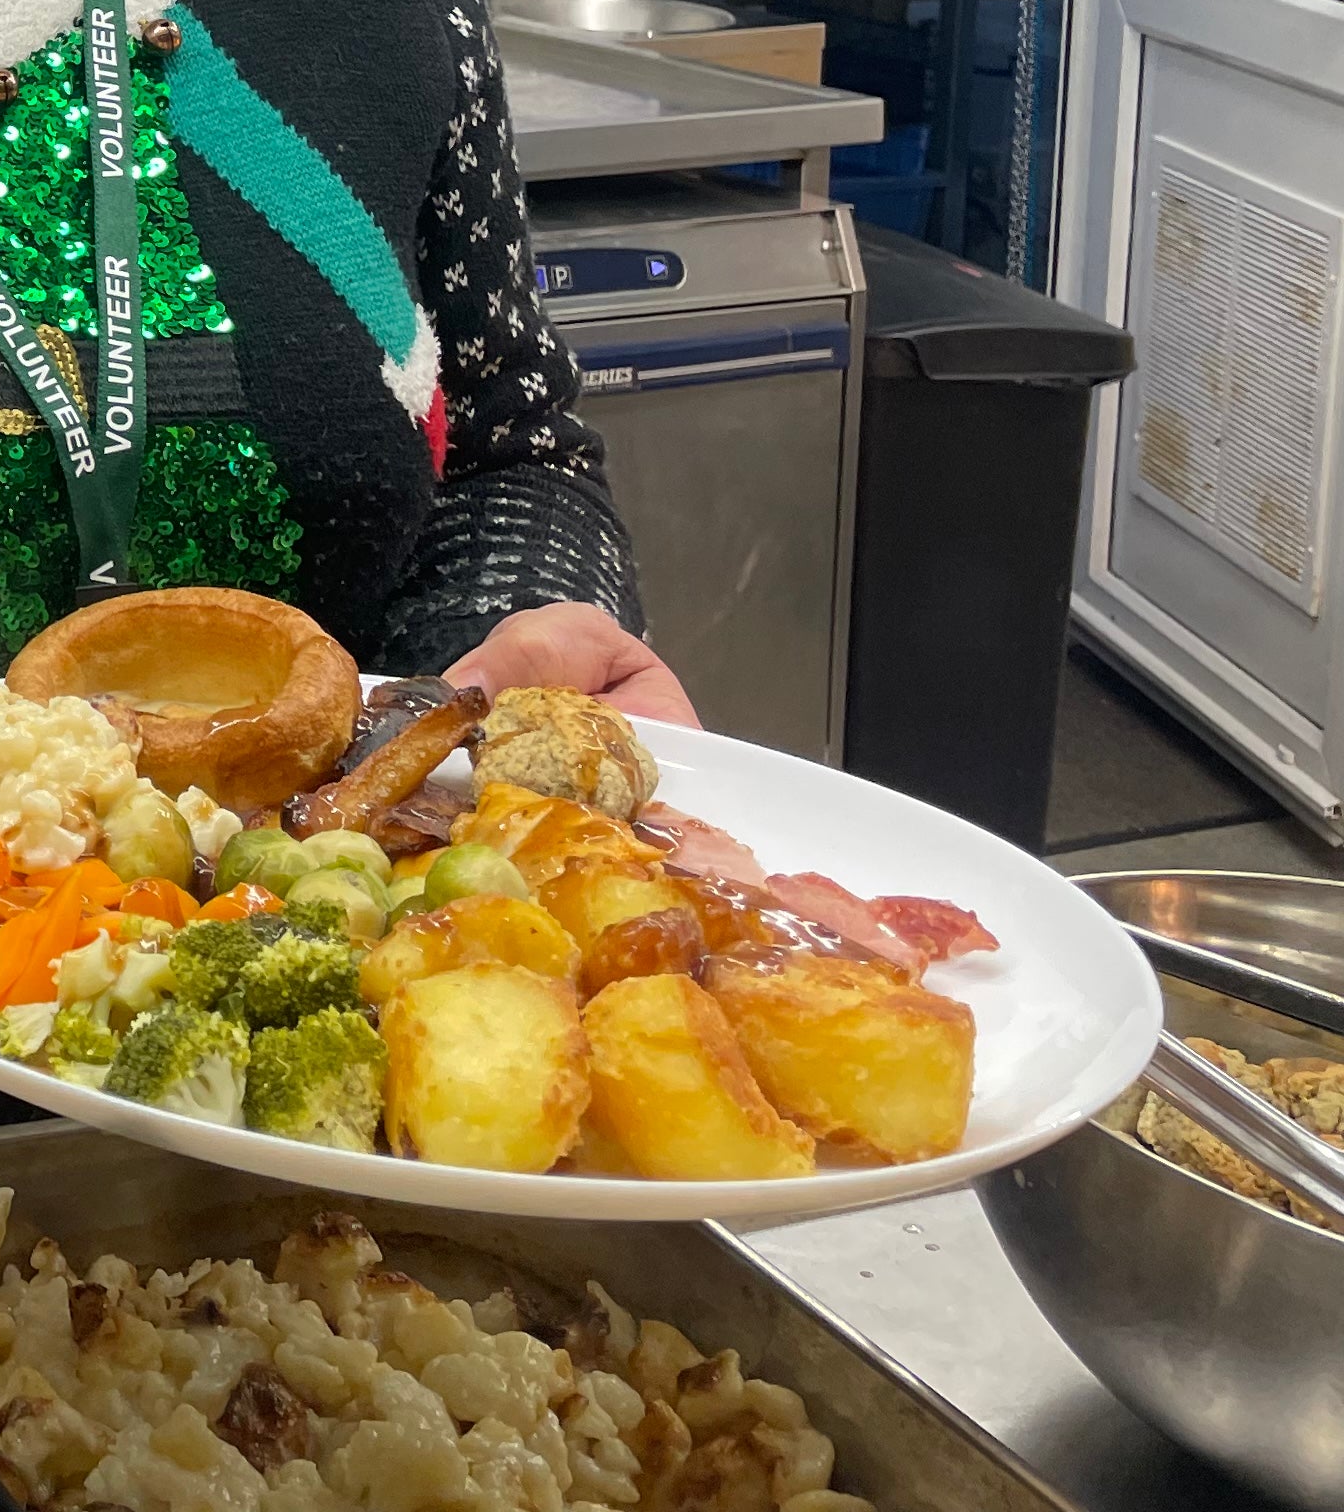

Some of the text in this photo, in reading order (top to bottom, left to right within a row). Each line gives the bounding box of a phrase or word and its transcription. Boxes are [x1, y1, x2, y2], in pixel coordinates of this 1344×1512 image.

[91, 8, 124, 179] VOLUNTEER
[104, 255, 134, 454] VOLUNTEER
[555, 267, 568, 288] P
